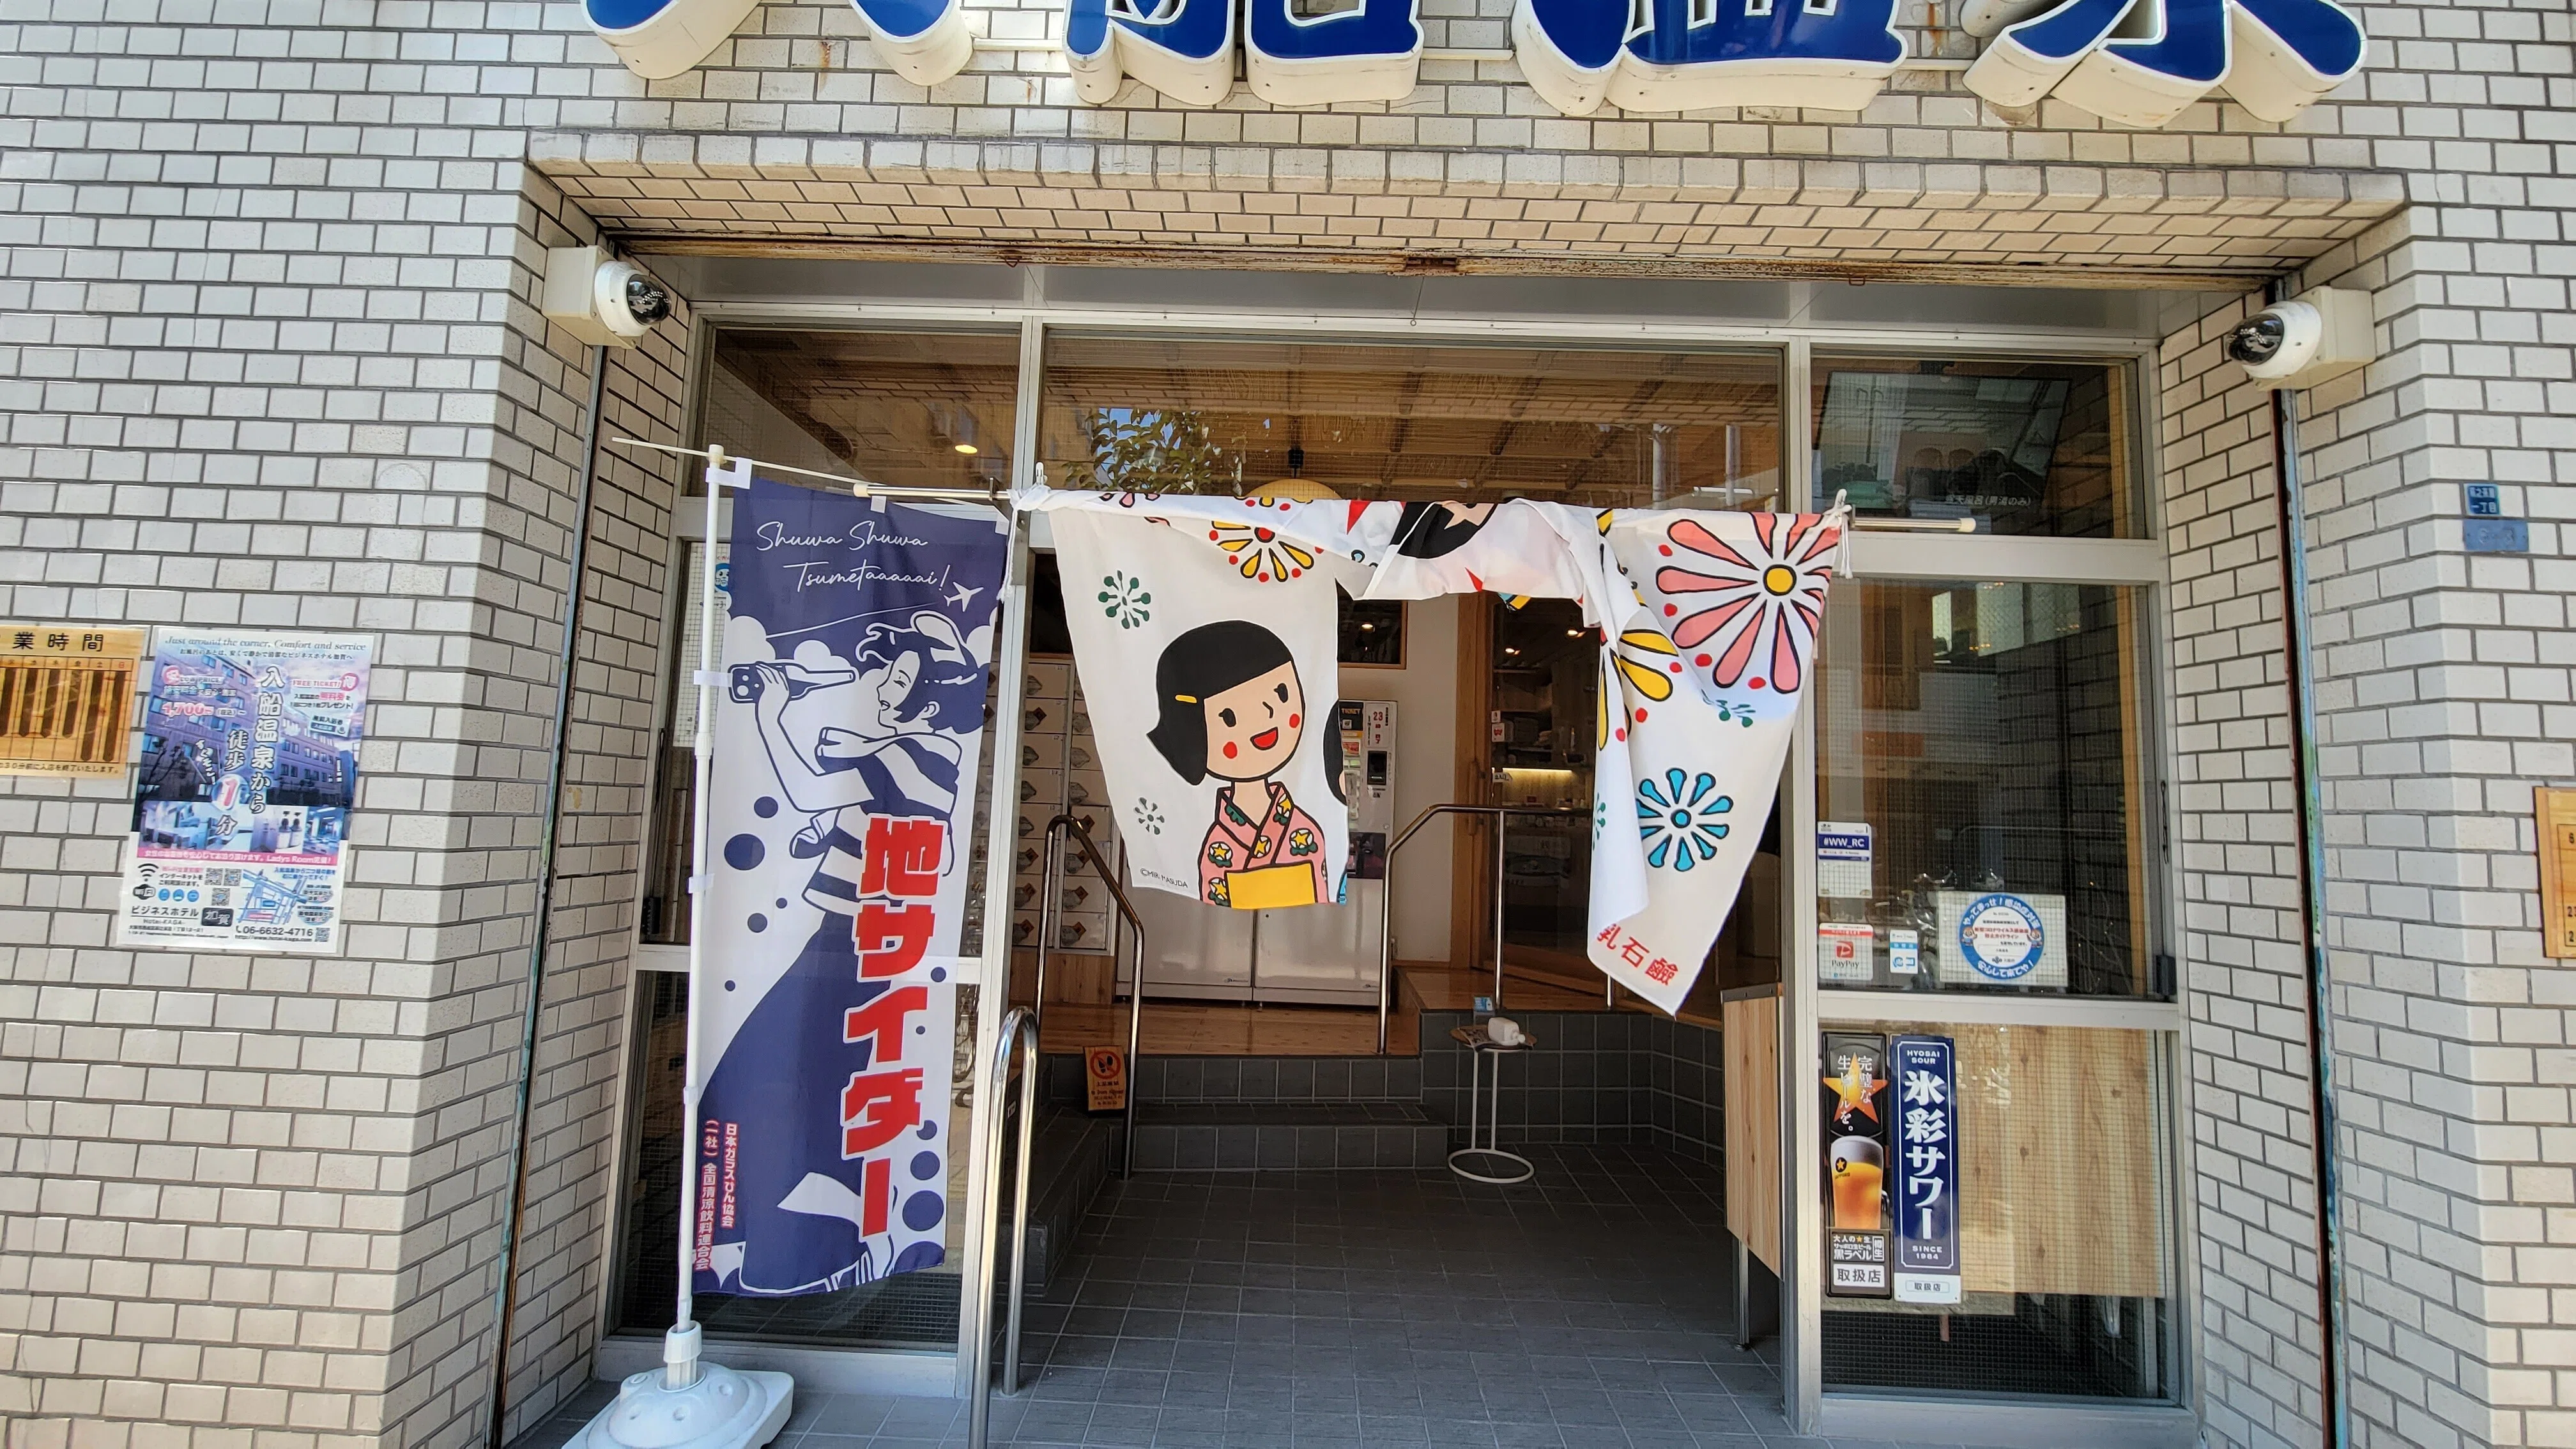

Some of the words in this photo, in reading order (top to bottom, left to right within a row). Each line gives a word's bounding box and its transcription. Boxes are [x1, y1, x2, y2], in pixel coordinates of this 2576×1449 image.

[756, 521, 843, 551] Shuwa
[848, 520, 928, 551] Shuwa
[165, 636, 186, 645] Just
[191, 638, 220, 646] around
[224, 637, 238, 646] the
[275, 639, 311, 650] Comfort
[314, 641, 332, 650] and
[334, 643, 366, 651] service
[1823, 836, 1865, 848] #WW_RC
[131, 905, 199, 917] ビジネスホテル
[243, 926, 313, 937] 06-6632-4716
[1832, 960, 1859, 970] PayPay
[844, 816, 946, 1238] 地サイダー
[1907, 1050, 1940, 1058] HYOSAI
[1904, 1070, 1947, 1241] 氷彩サワー
[1833, 1248, 1872, 1261] 黒ラベル
[1837, 1268, 1882, 1283] 取扱店
[1914, 1282, 1941, 1291] 取扱店
